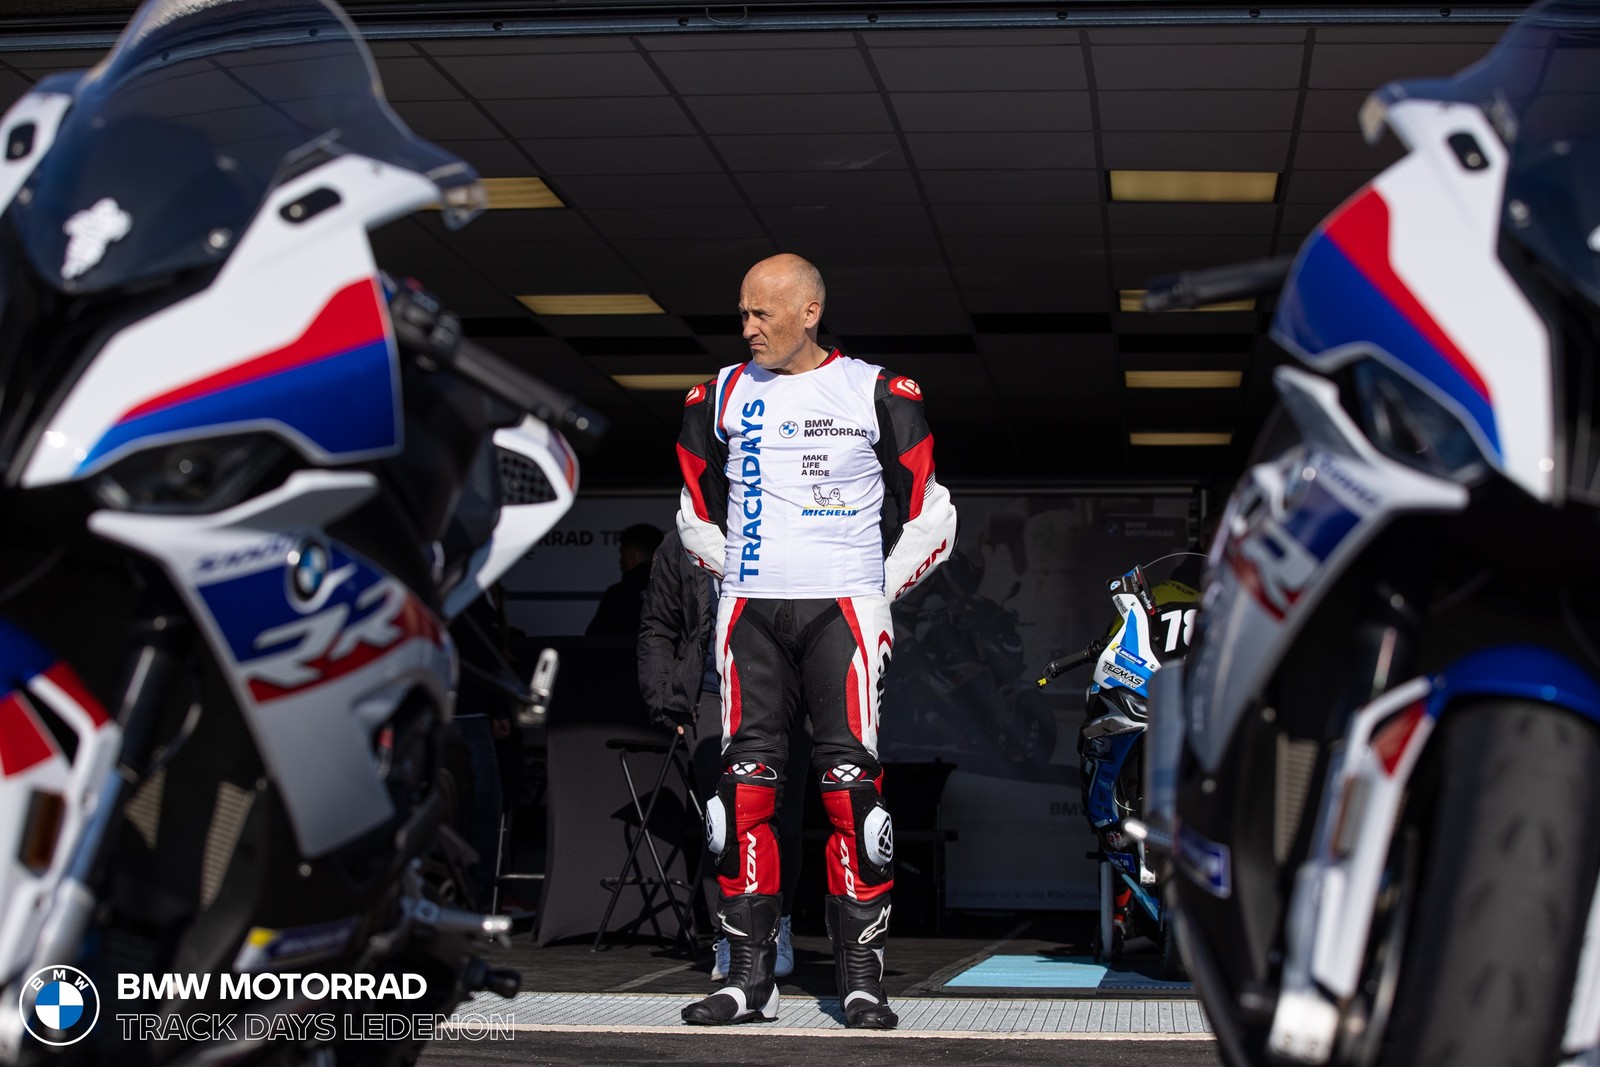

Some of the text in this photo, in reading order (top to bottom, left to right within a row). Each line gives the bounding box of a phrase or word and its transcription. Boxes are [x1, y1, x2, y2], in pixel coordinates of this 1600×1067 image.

[804, 419, 833, 428] BMW
[804, 427, 867, 437] MOTORRAD
[739, 399, 765, 582] TRACKDAYS
